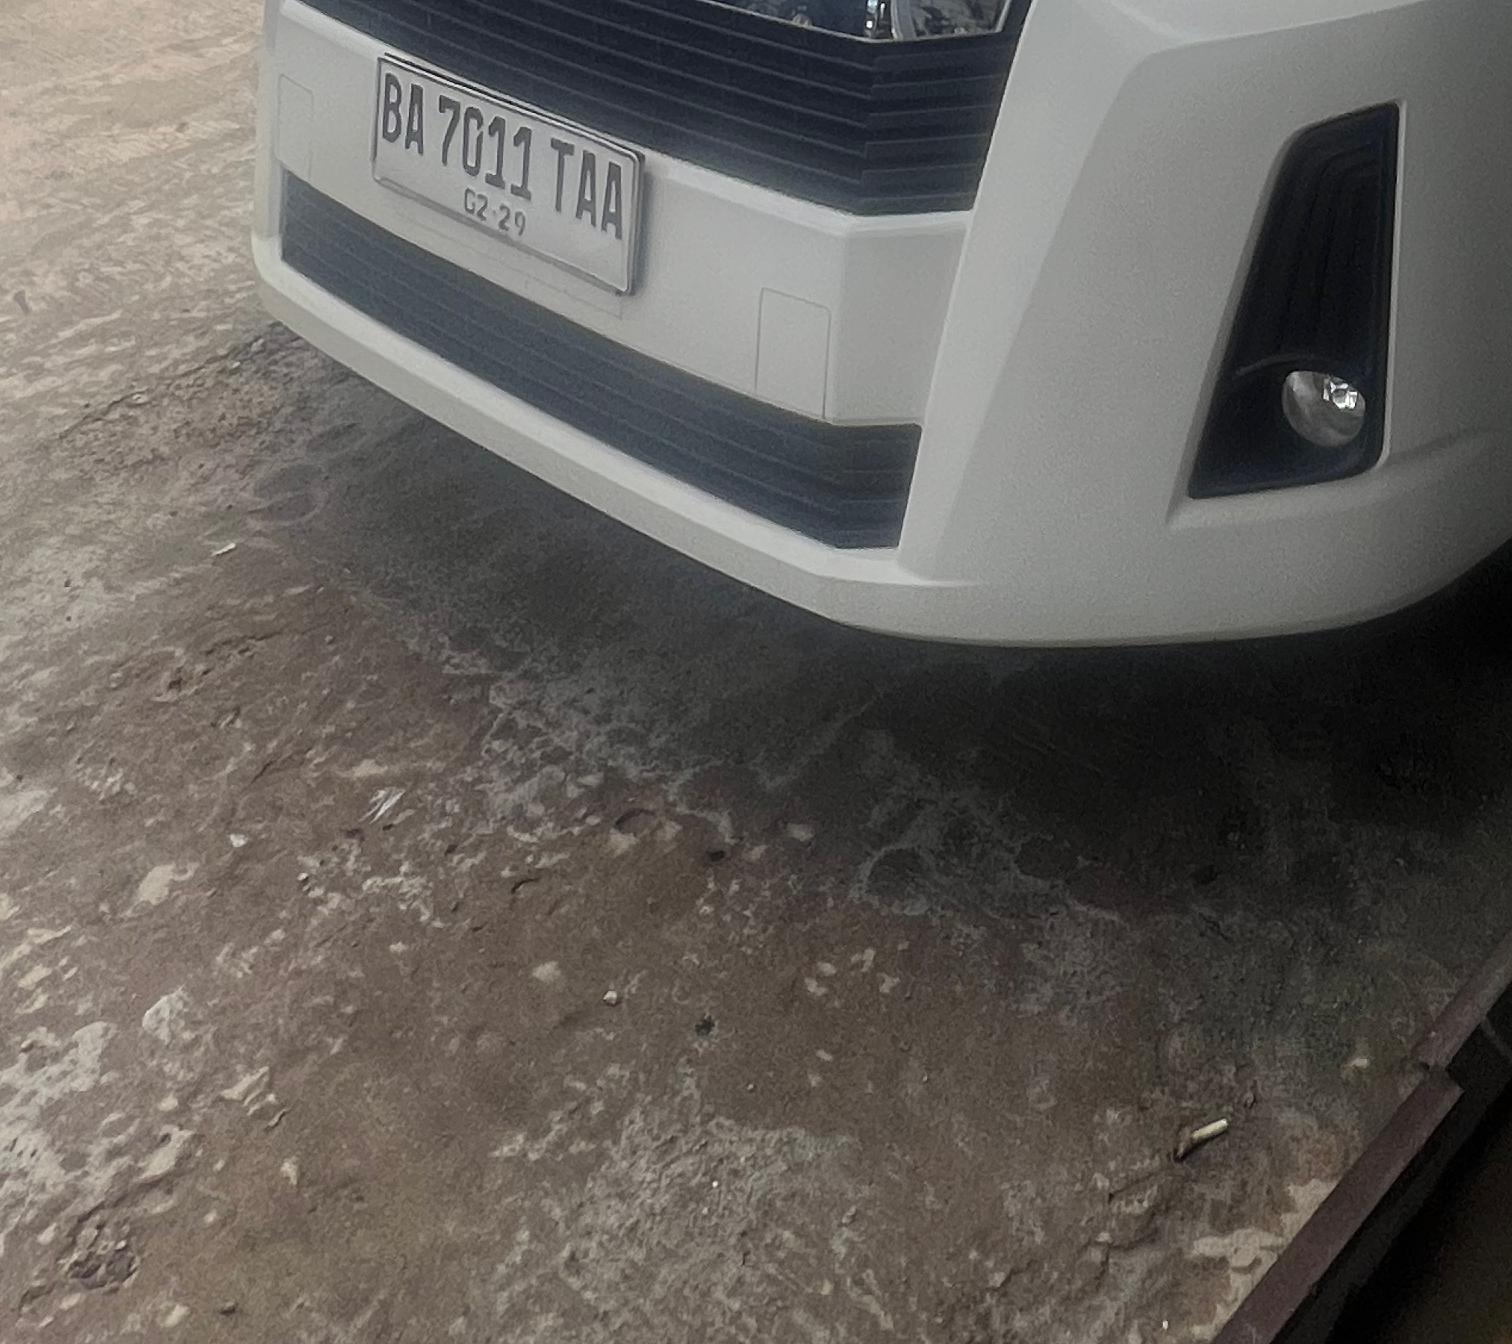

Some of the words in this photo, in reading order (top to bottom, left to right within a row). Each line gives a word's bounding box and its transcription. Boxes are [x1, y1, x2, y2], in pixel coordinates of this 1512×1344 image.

[382, 72, 424, 156] BA
[438, 95, 532, 201] 7011
[551, 137, 622, 241] TAA
